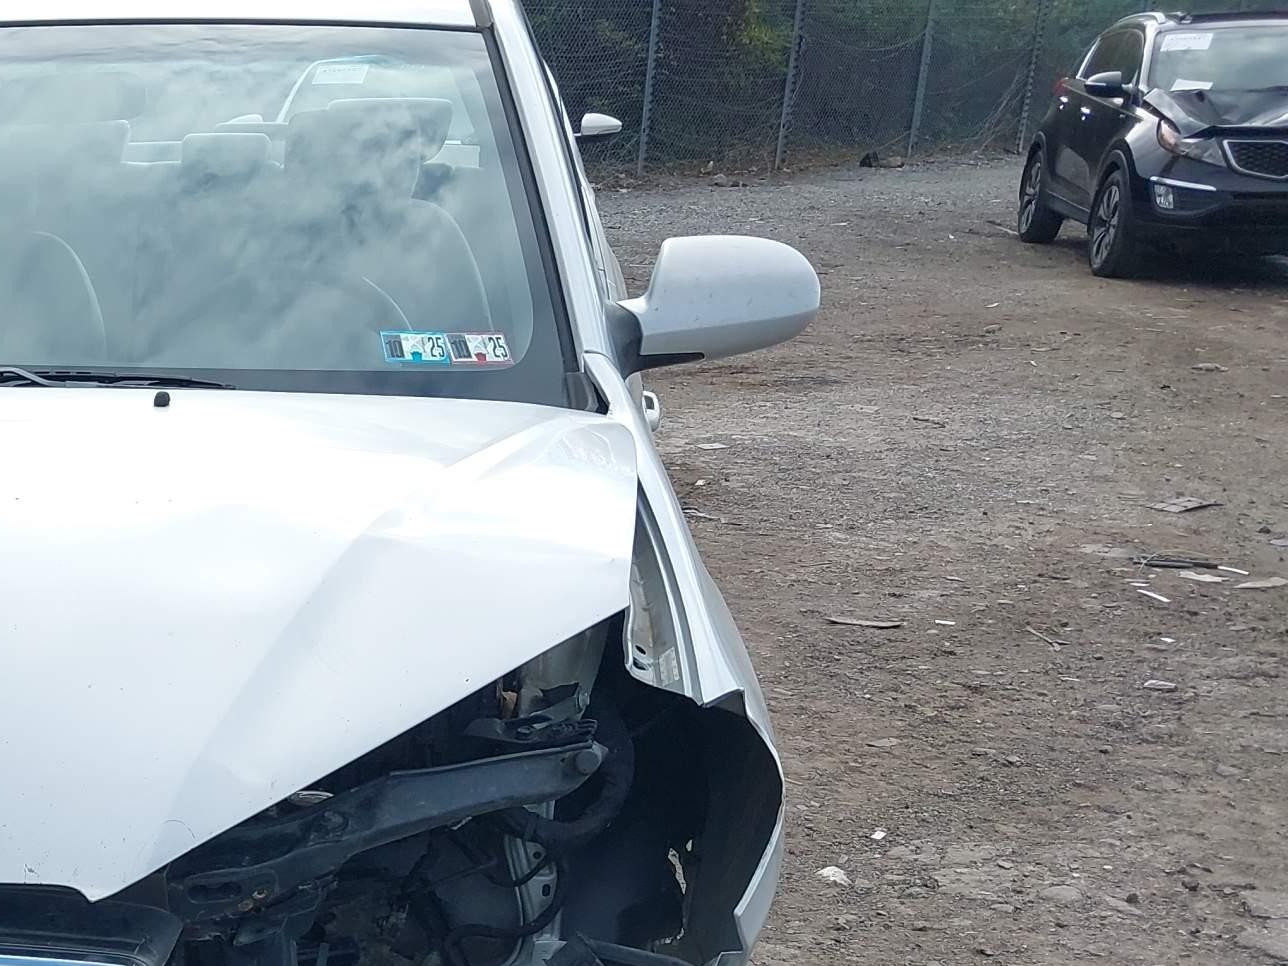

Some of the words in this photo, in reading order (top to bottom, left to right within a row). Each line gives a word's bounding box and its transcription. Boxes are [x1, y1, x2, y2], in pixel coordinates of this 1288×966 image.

[386, 339, 405, 358] 10
[428, 337, 445, 358] 25
[488, 337, 509, 358] 25
